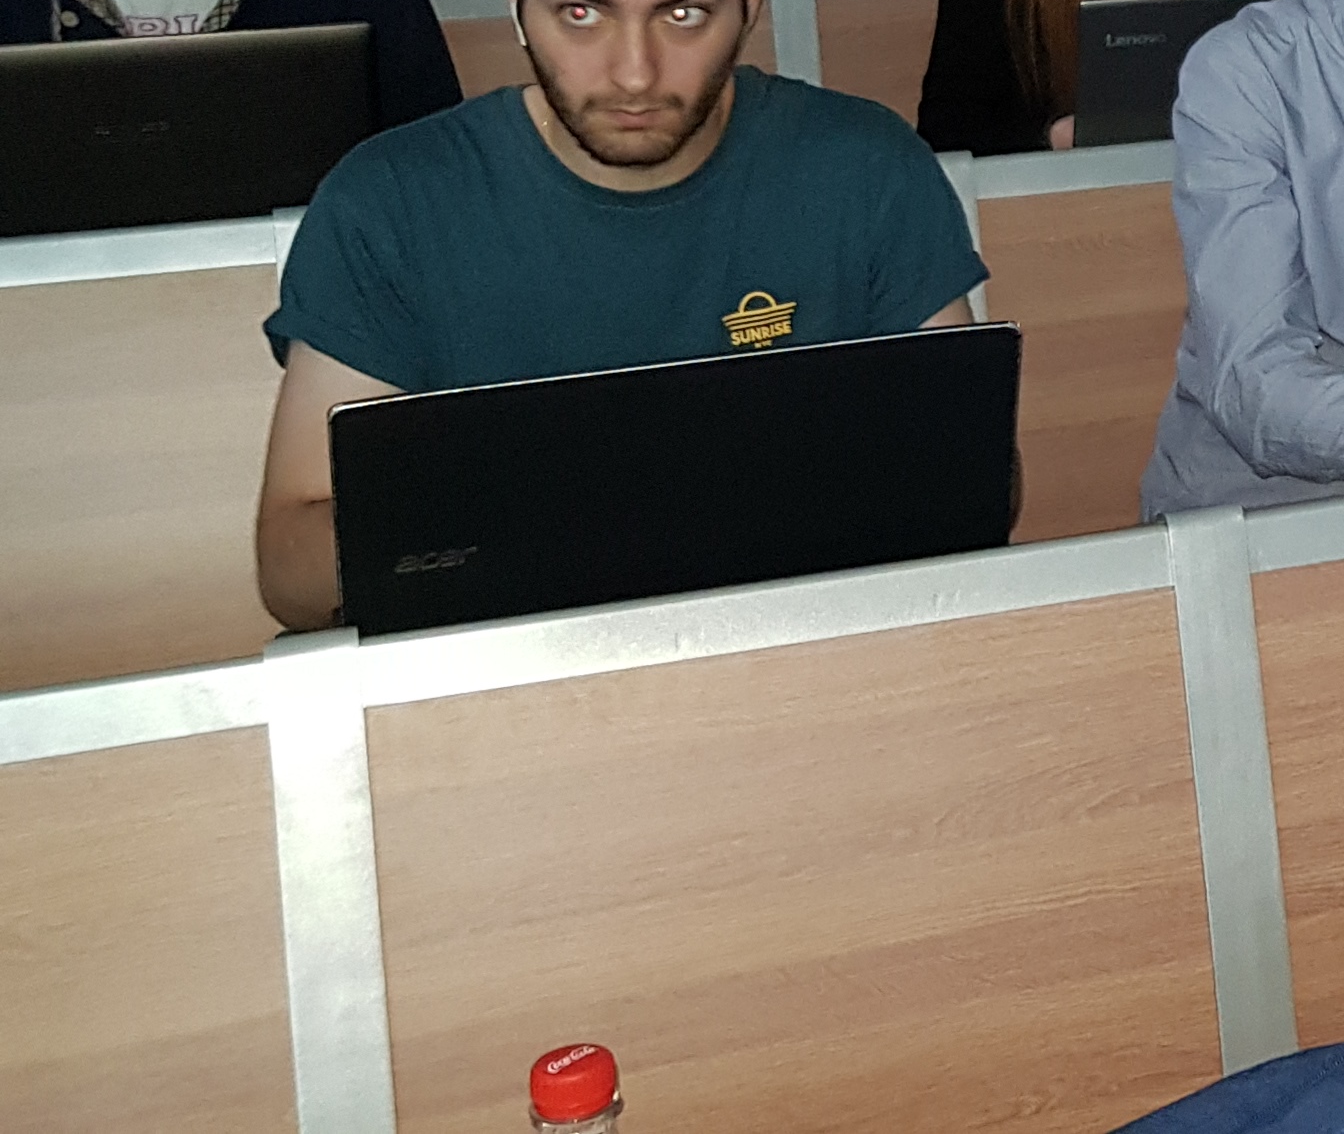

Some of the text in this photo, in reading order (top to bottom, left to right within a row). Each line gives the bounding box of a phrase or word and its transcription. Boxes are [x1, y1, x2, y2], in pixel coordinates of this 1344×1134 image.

[1105, 33, 1167, 48] Lenovo
[730, 321, 793, 346] SUNRISE
[394, 546, 477, 573] acer
